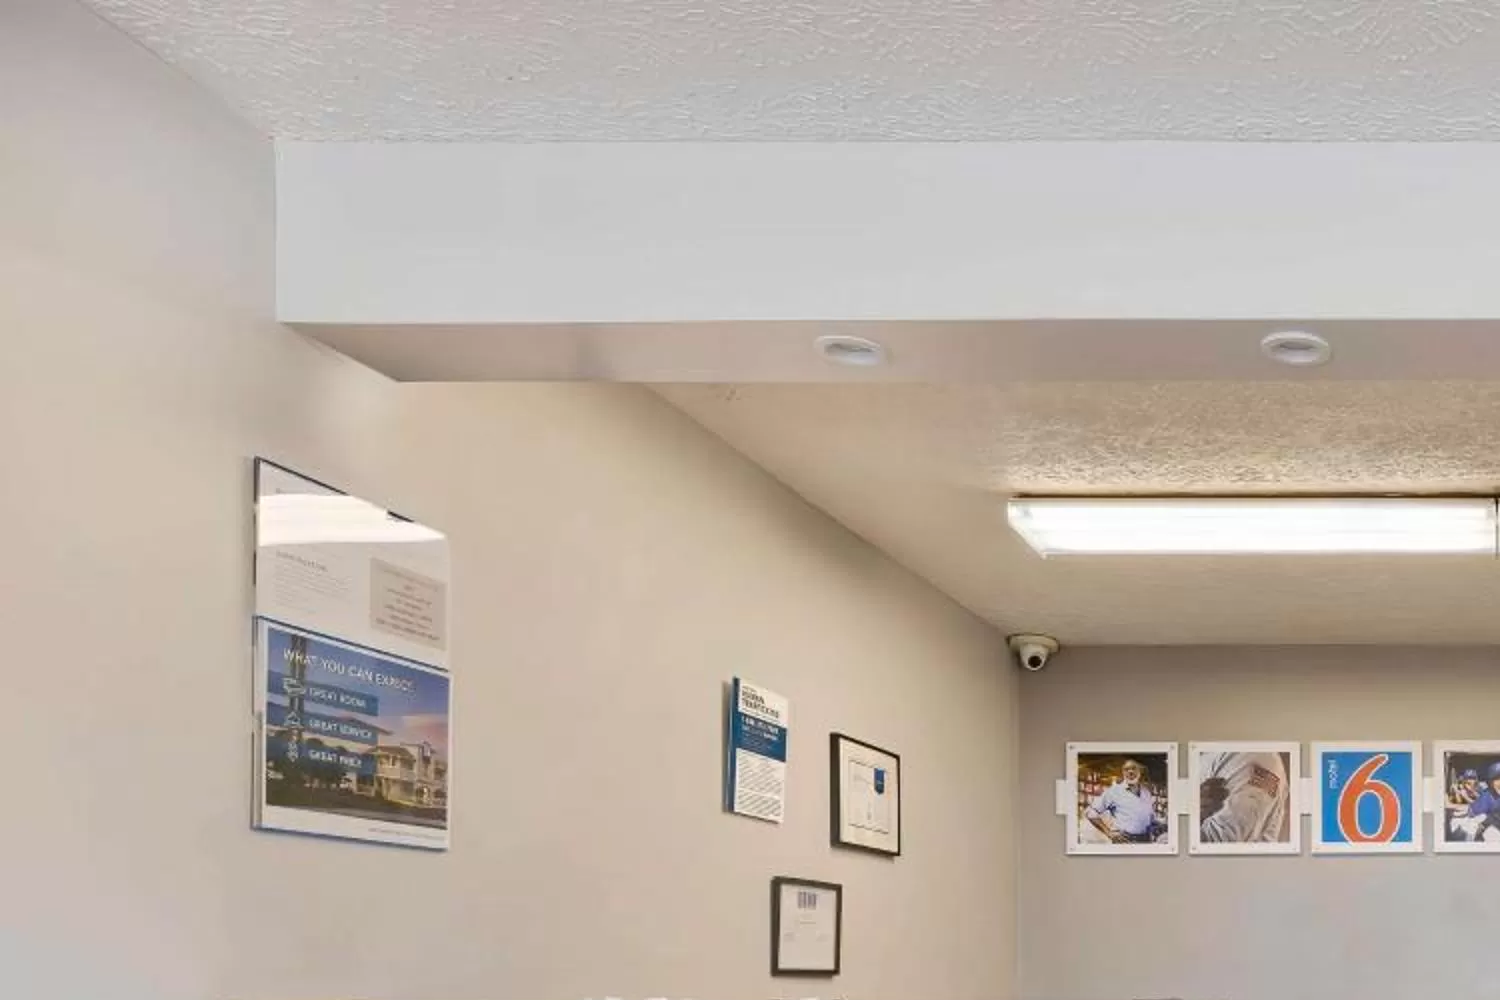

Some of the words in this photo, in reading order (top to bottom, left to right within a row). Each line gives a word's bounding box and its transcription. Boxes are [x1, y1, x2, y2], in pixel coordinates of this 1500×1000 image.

[283, 648, 317, 666] WHAT
[321, 655, 346, 675] YOU
[348, 666, 373, 683] CAN
[1337, 753, 1401, 845] 6
